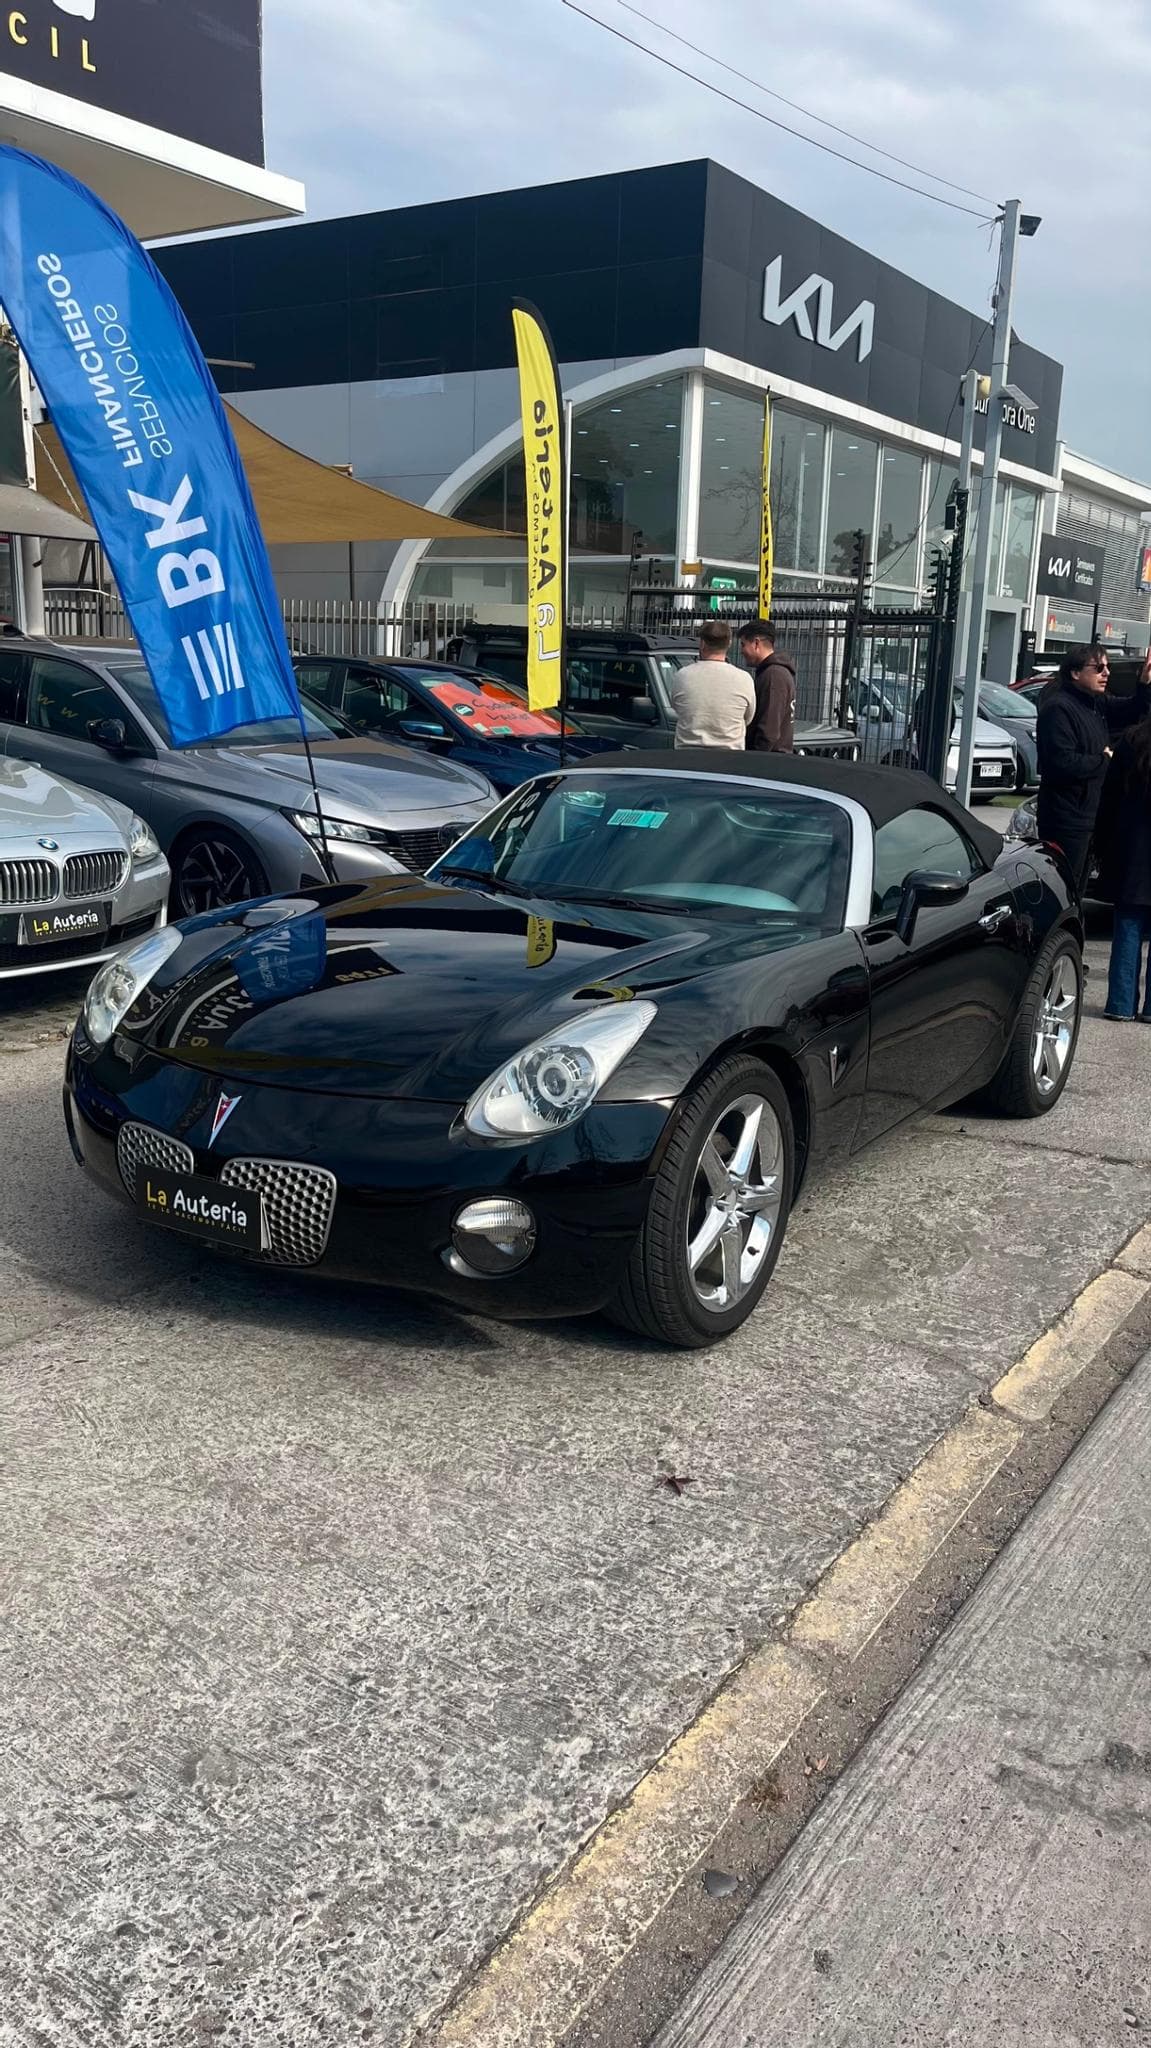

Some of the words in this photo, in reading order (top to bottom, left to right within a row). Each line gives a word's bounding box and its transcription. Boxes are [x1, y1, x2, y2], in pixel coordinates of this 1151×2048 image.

[762, 254, 875, 363] KIA
[1018, 406, 1035, 434] One
[1047, 557, 1071, 578] KIA
[33, 919, 50, 933] La
[53, 909, 99, 930] Autería
[147, 1181, 167, 1206] La
[173, 1189, 247, 1227] Autería
[175, 1211, 215, 1226] HACEMOS
